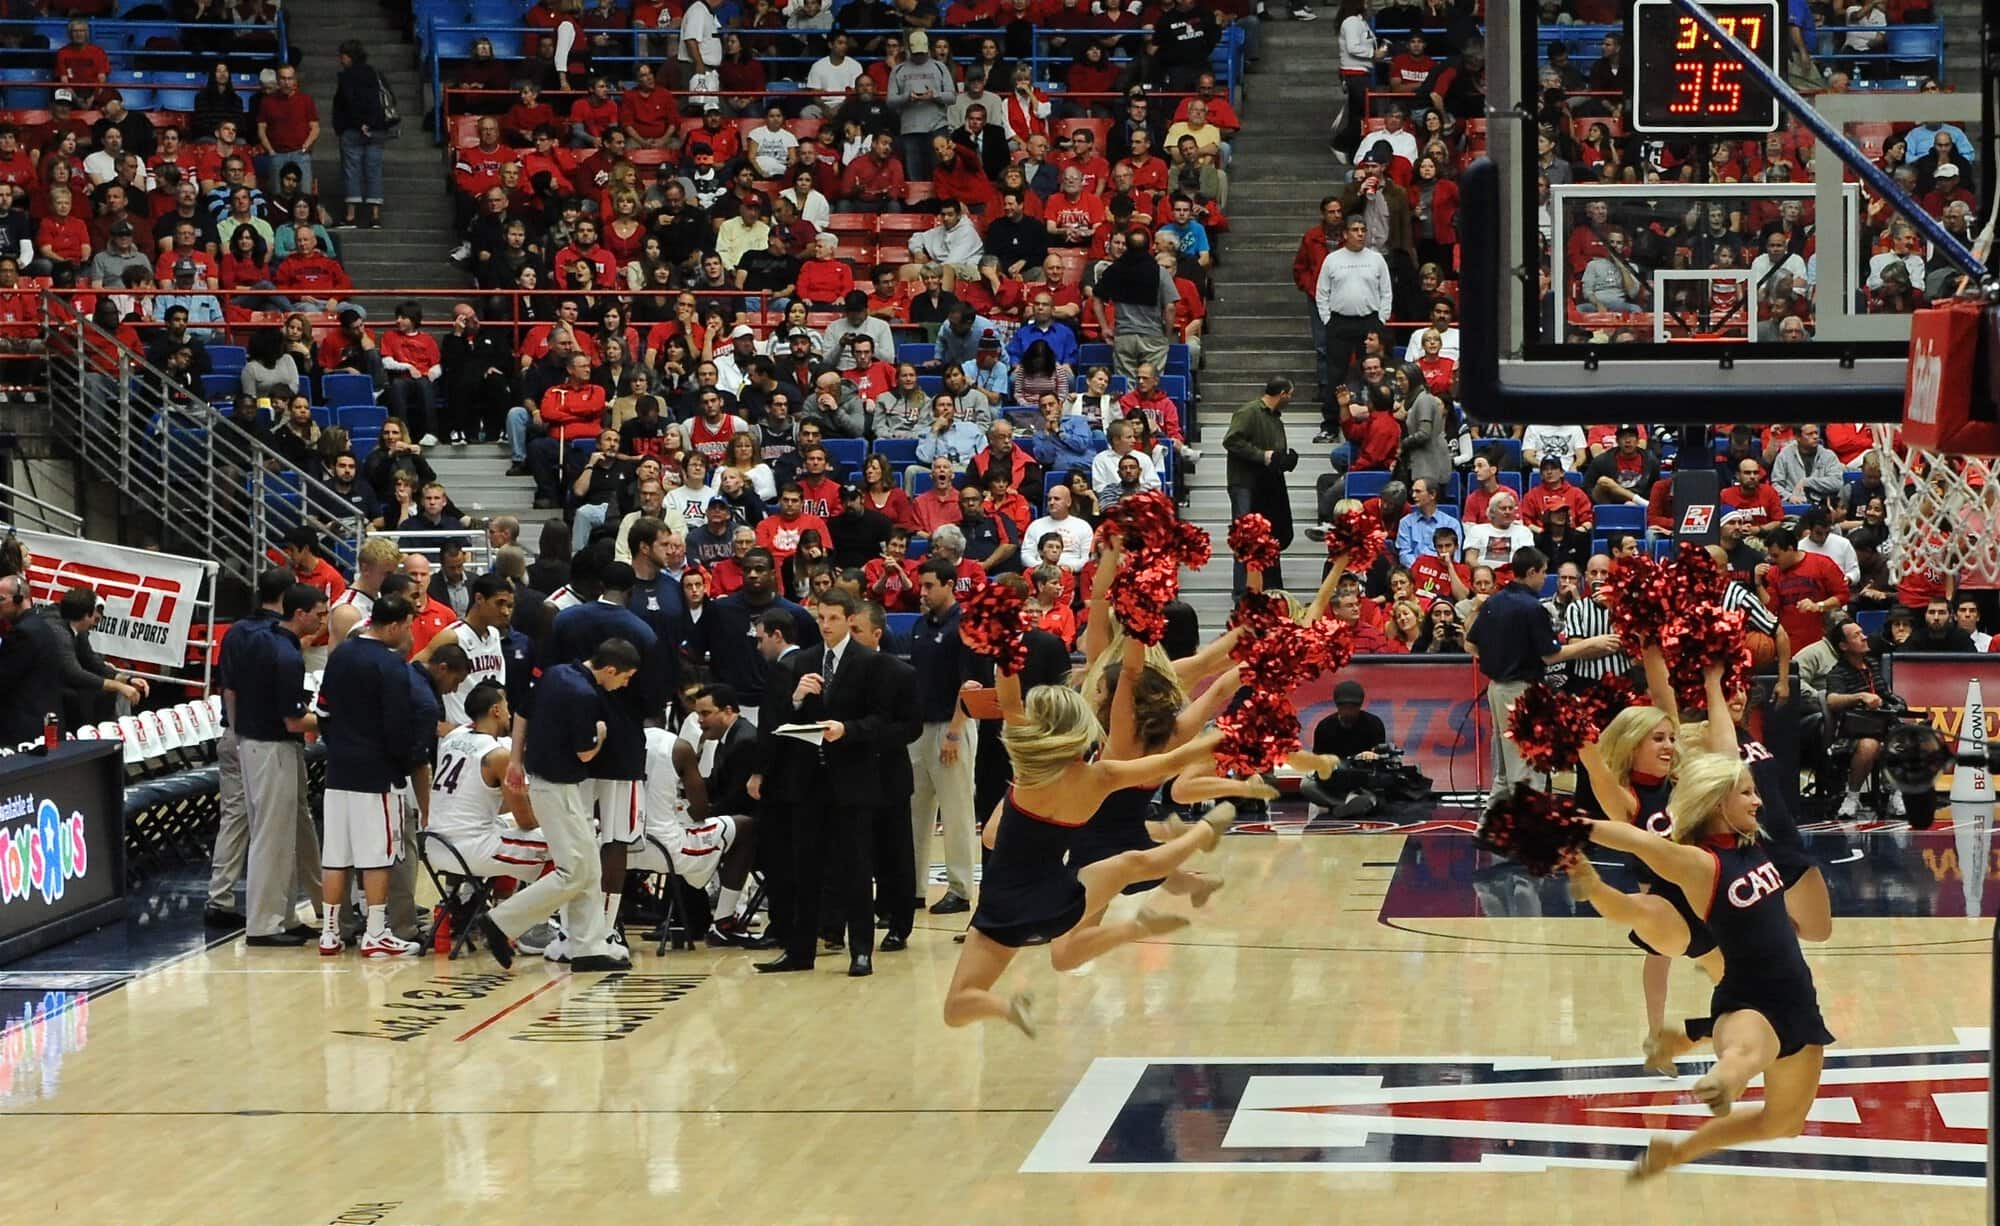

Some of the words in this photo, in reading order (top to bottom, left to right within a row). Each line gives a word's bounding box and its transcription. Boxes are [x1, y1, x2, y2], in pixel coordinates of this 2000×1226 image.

[1670, 62, 1742, 113] 35
[683, 501, 706, 518] A
[27, 553, 181, 624] ESPN
[118, 619, 130, 638] IN
[130, 622, 169, 645] SPORTS
[432, 752, 466, 794] 24
[568, 973, 712, 1003] COURT
